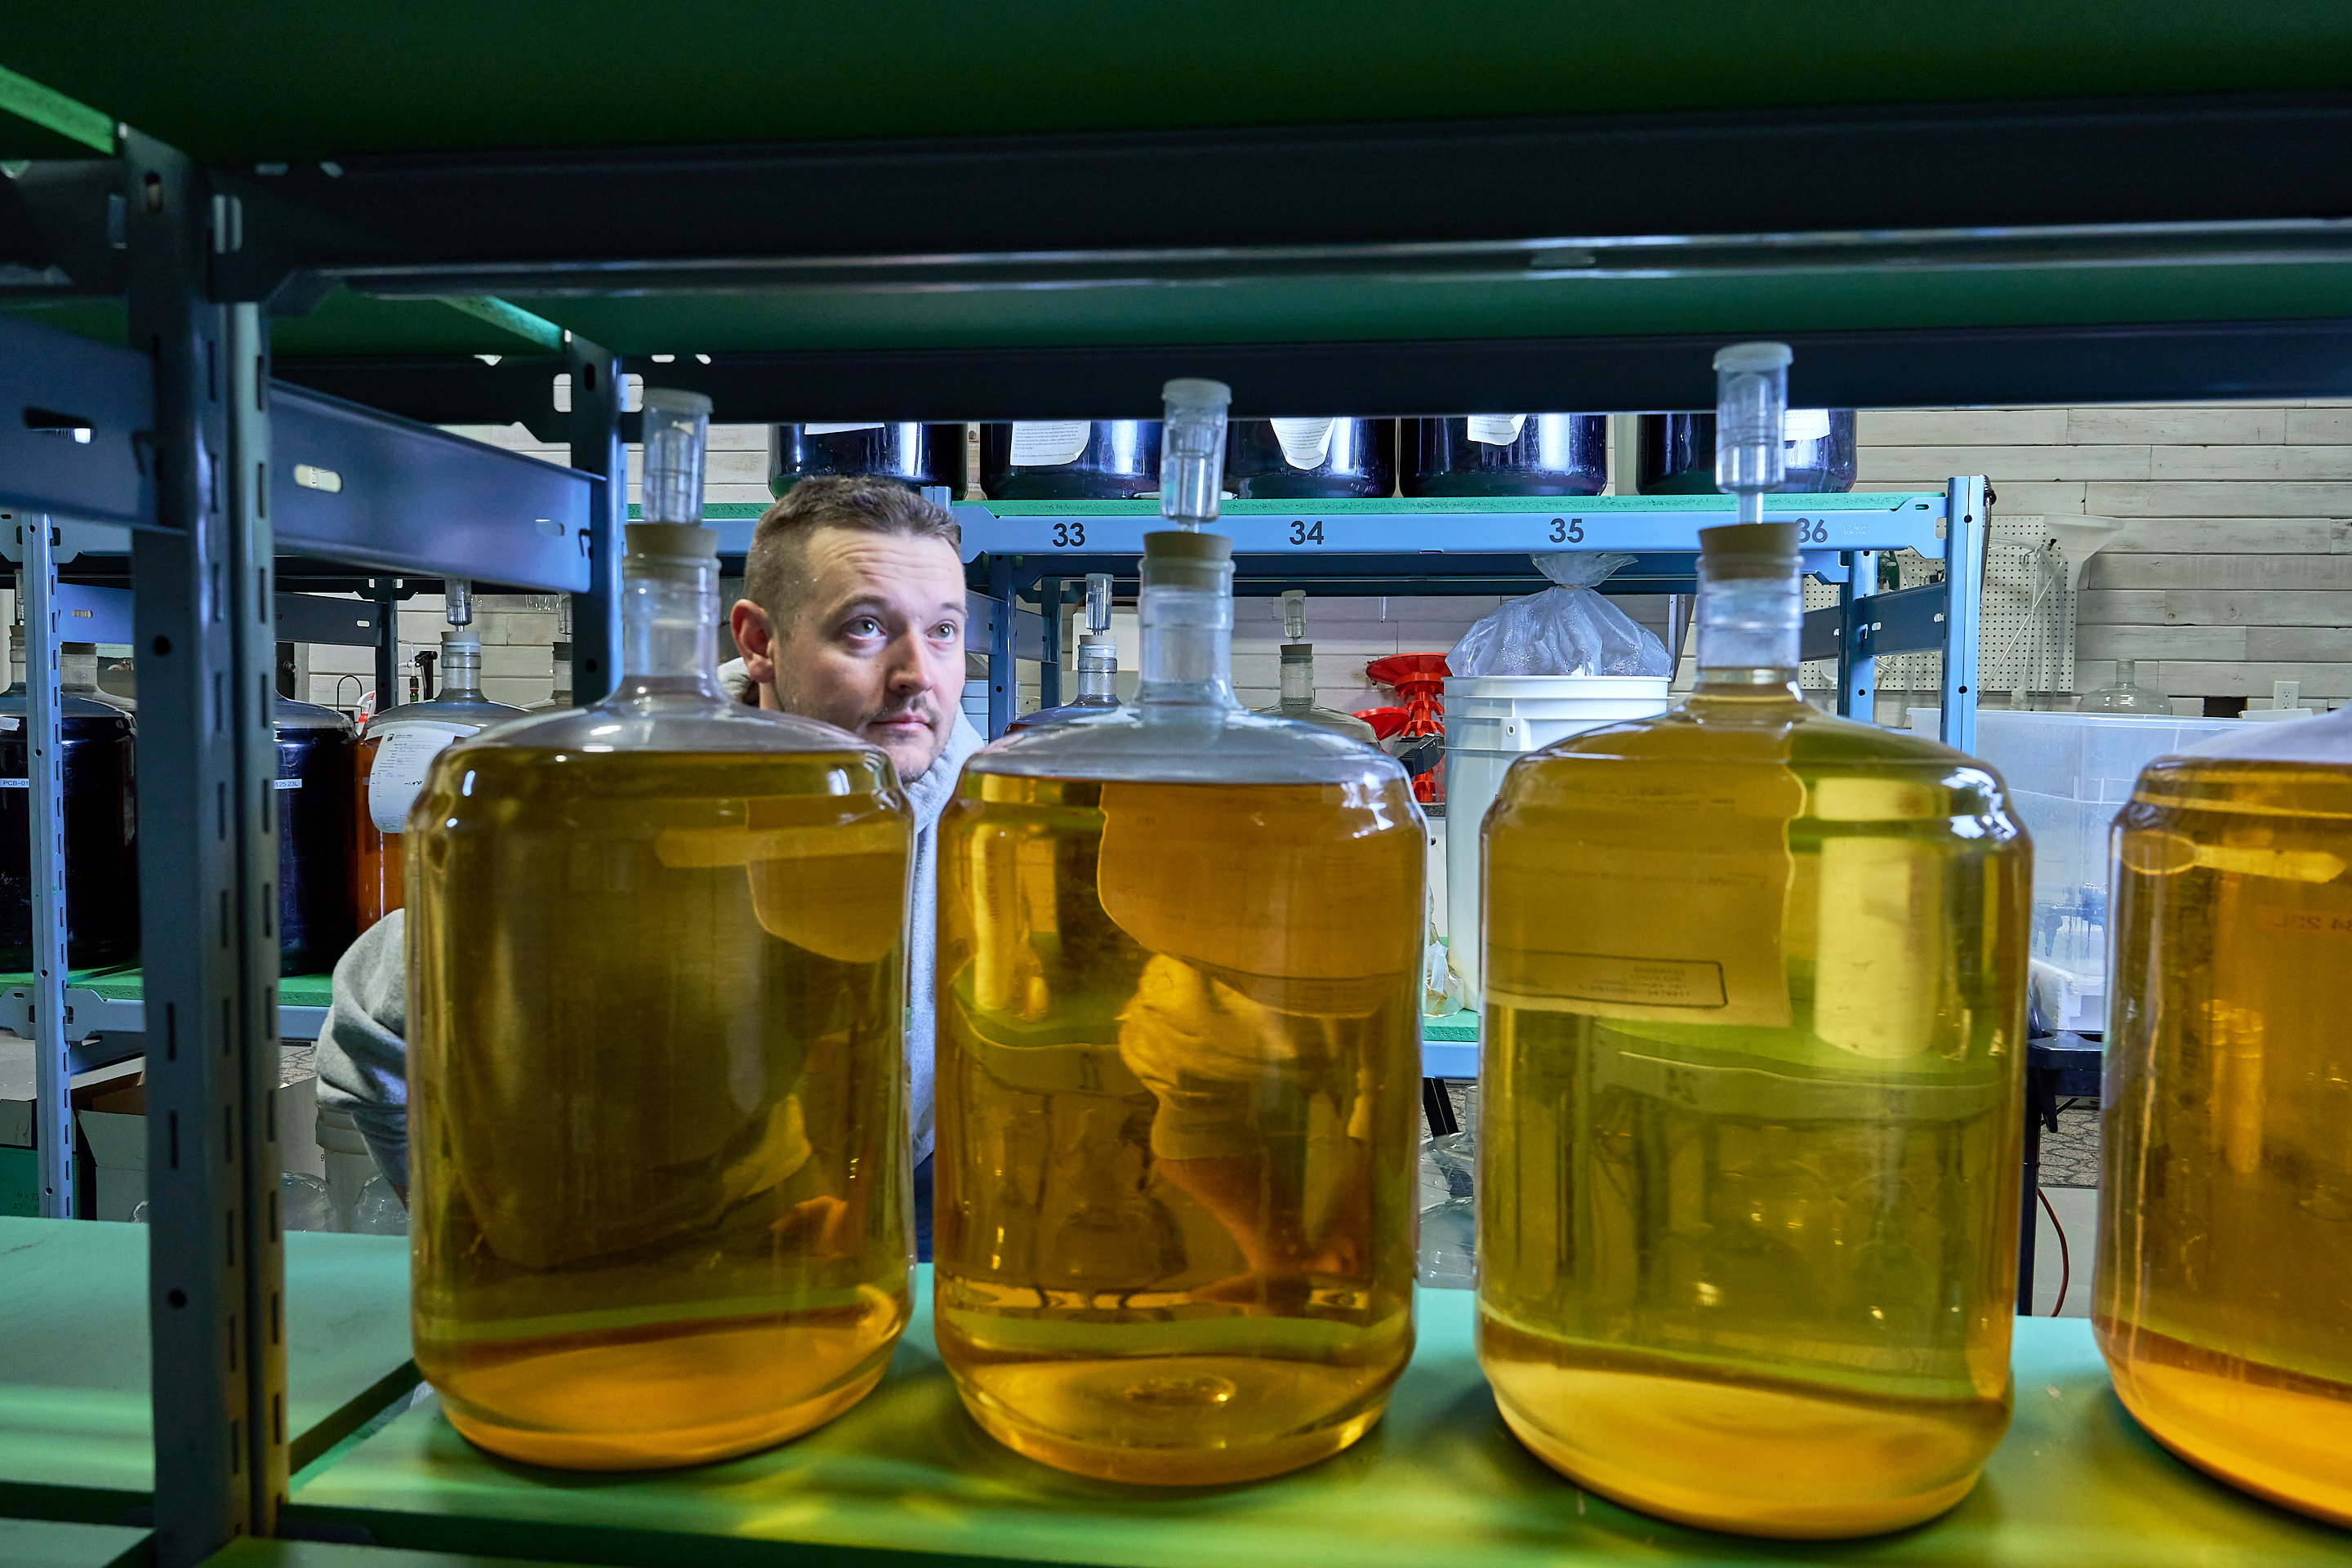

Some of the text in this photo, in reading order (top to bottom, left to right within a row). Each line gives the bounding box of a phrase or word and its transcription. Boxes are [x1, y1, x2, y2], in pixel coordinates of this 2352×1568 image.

[1053, 523, 1085, 547] 33
[1290, 520, 1324, 545] 34
[1549, 518, 1584, 543] 35
